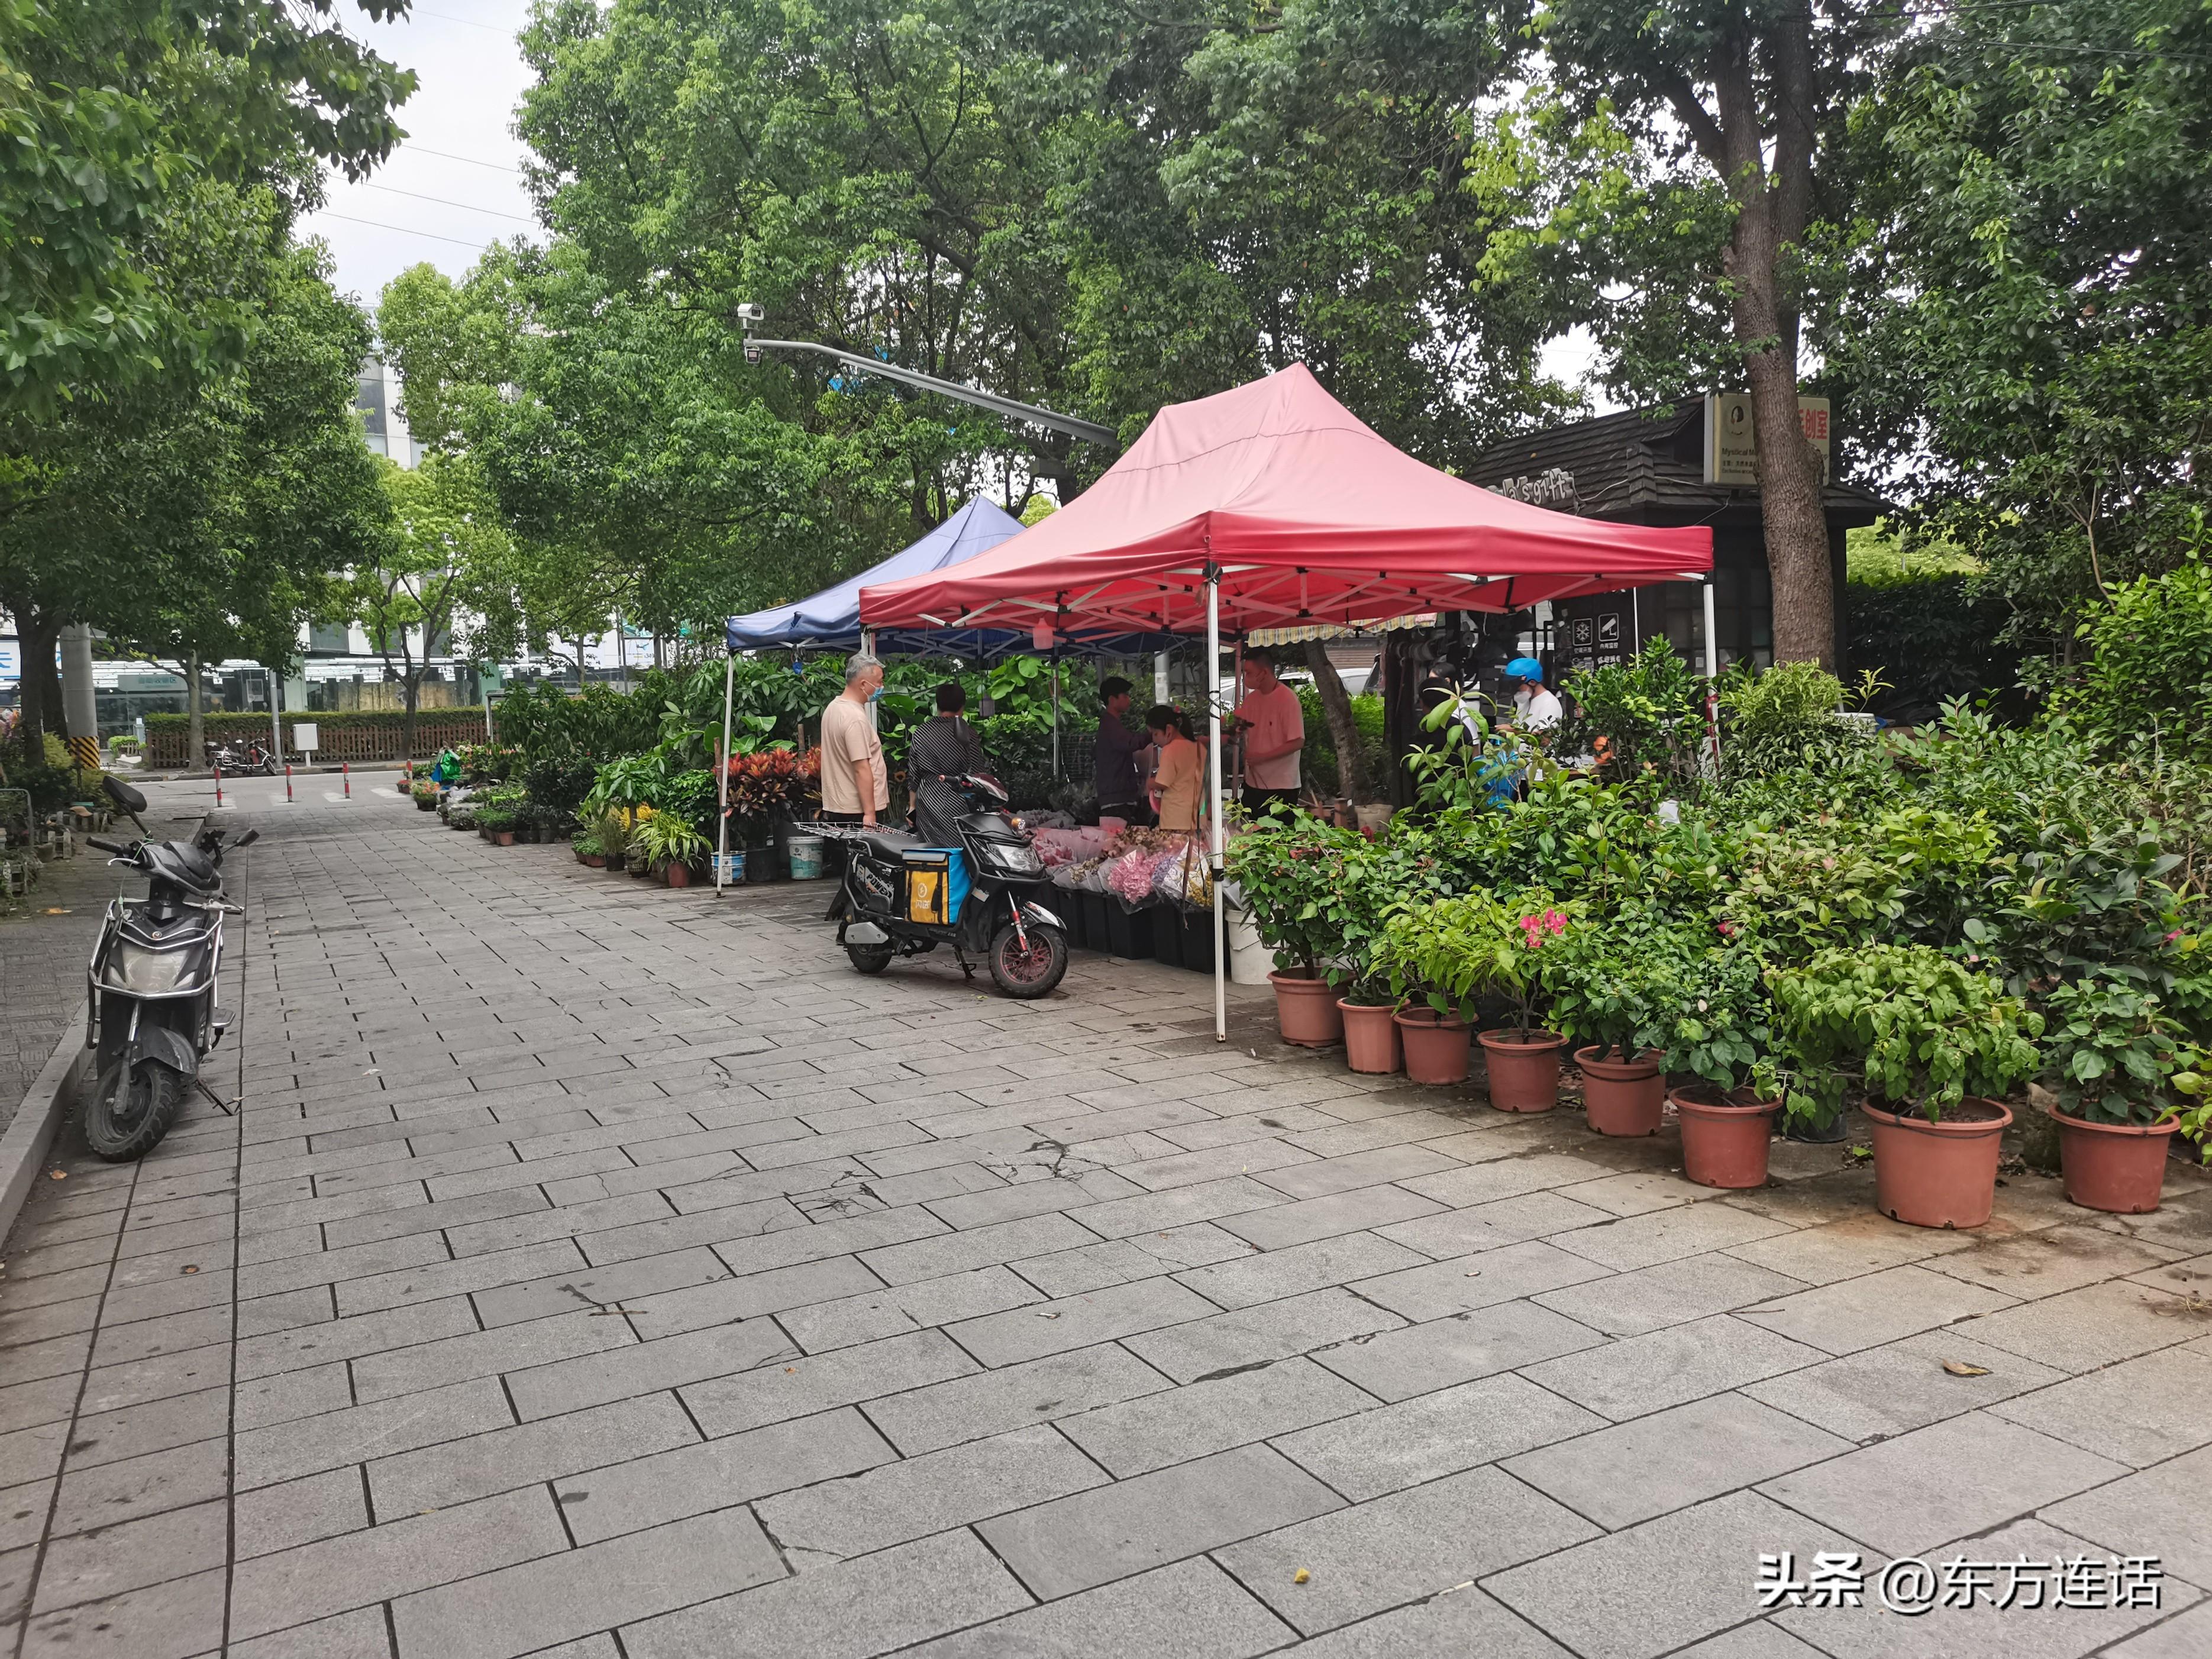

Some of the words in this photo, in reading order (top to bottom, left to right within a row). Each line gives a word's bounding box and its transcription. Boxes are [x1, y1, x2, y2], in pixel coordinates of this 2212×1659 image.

[1722, 447, 1748, 457] Mystical
[1533, 468, 1568, 505] gift
[915, 899, 931, 909] 闪送
